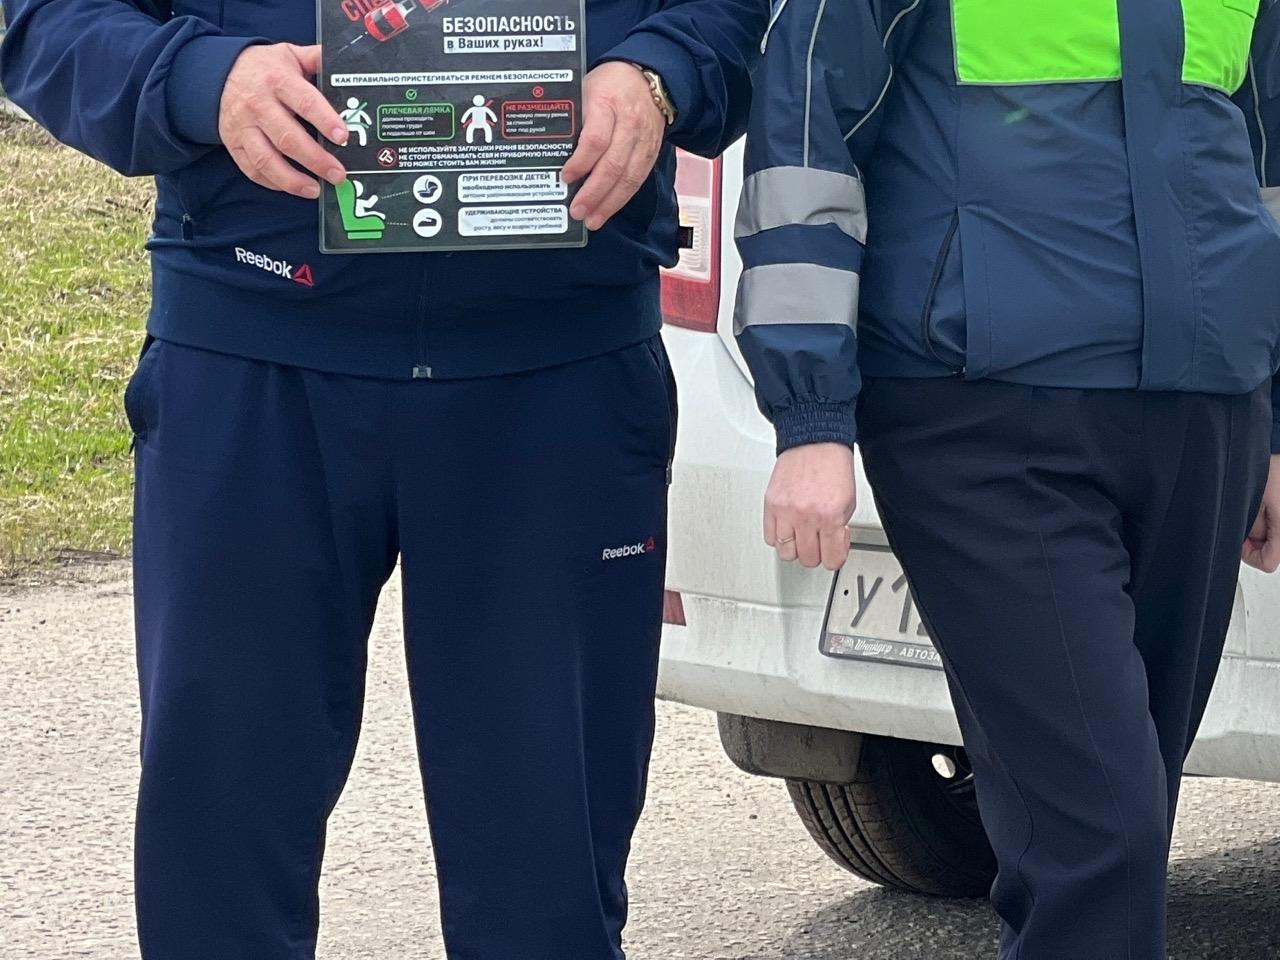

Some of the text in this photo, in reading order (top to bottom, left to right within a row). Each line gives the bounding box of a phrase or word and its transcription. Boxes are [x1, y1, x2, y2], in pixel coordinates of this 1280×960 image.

[442, 15, 576, 33] БЕЗОПАСНОСТЬ
[446, 36, 545, 52] в Ваших руках!
[401, 74, 470, 82] ПРИСТЕГИВАТЬСЯ
[503, 72, 569, 80] БЕЗОПАСНОСТИ?
[382, 106, 423, 114] ПЛЕЧЕВАЯ
[408, 145, 457, 153] ИСПОЛЬЗУЙТЕ
[458, 144, 494, 152] ЗАГЛУШКИ
[431, 152, 477, 160] ОБМАНЫВАТЬ
[525, 172, 551, 181] ДЕТЕЙ
[234, 246, 293, 280] Reebok
[602, 542, 646, 560] Reebok
[850, 572, 929, 637] У1
[899, 647, 943, 662] АВТОЗА
